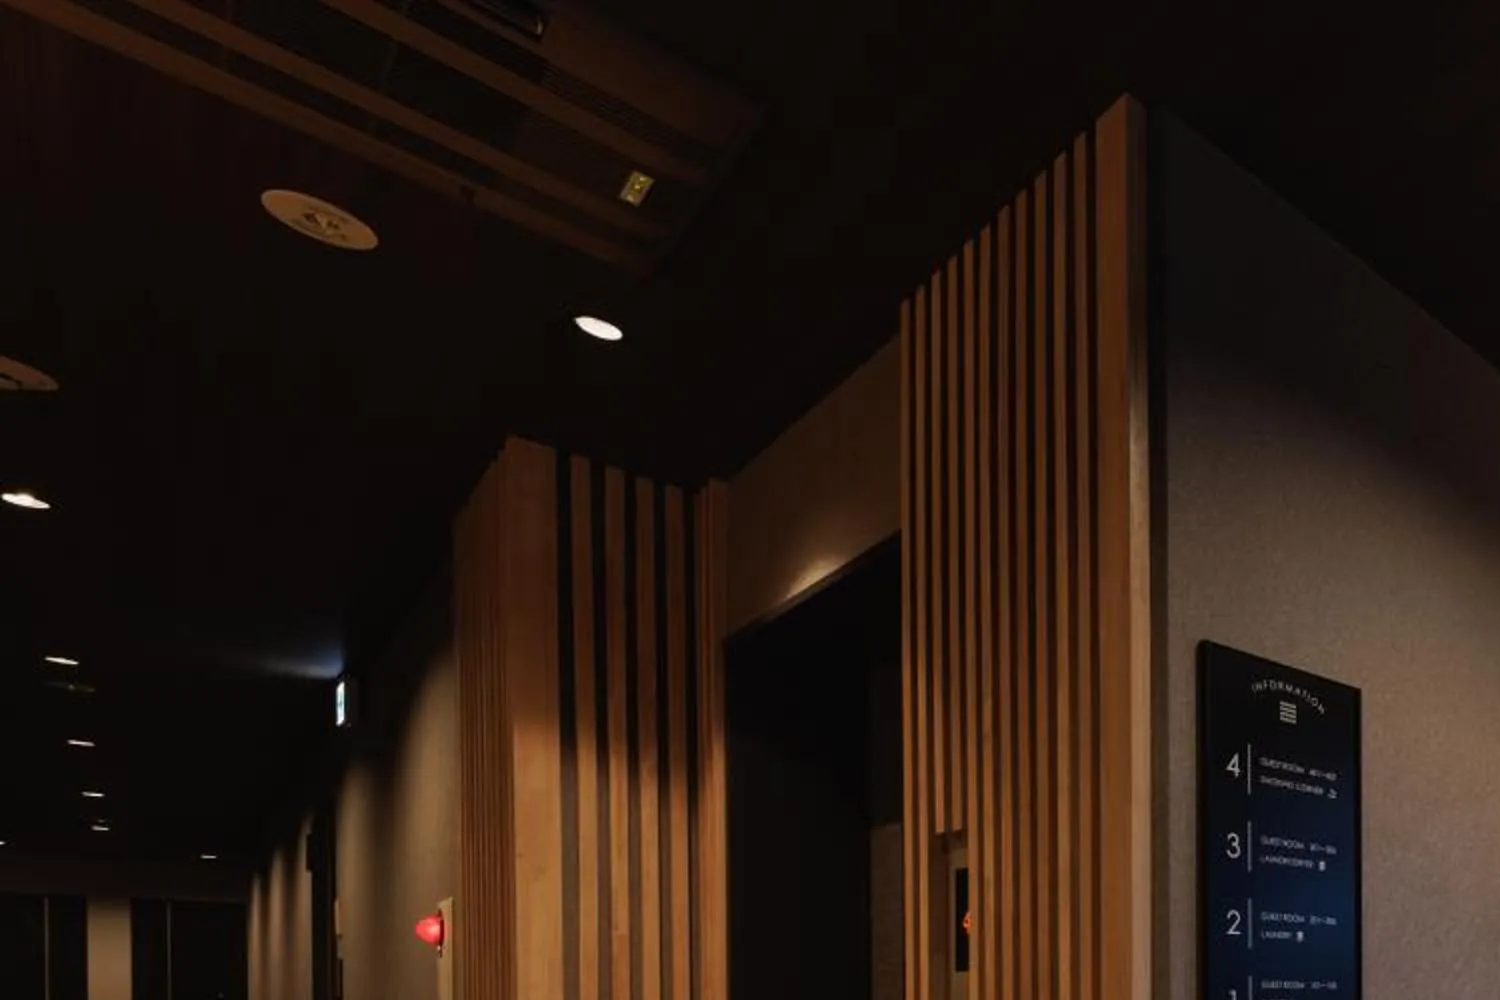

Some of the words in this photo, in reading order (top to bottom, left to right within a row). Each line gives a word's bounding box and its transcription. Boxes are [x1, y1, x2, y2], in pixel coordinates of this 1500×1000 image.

[1251, 679, 1326, 715] INFORMATION
[1225, 752, 1241, 778] 4
[1226, 832, 1241, 859] 3
[1226, 909, 1242, 935] 2
